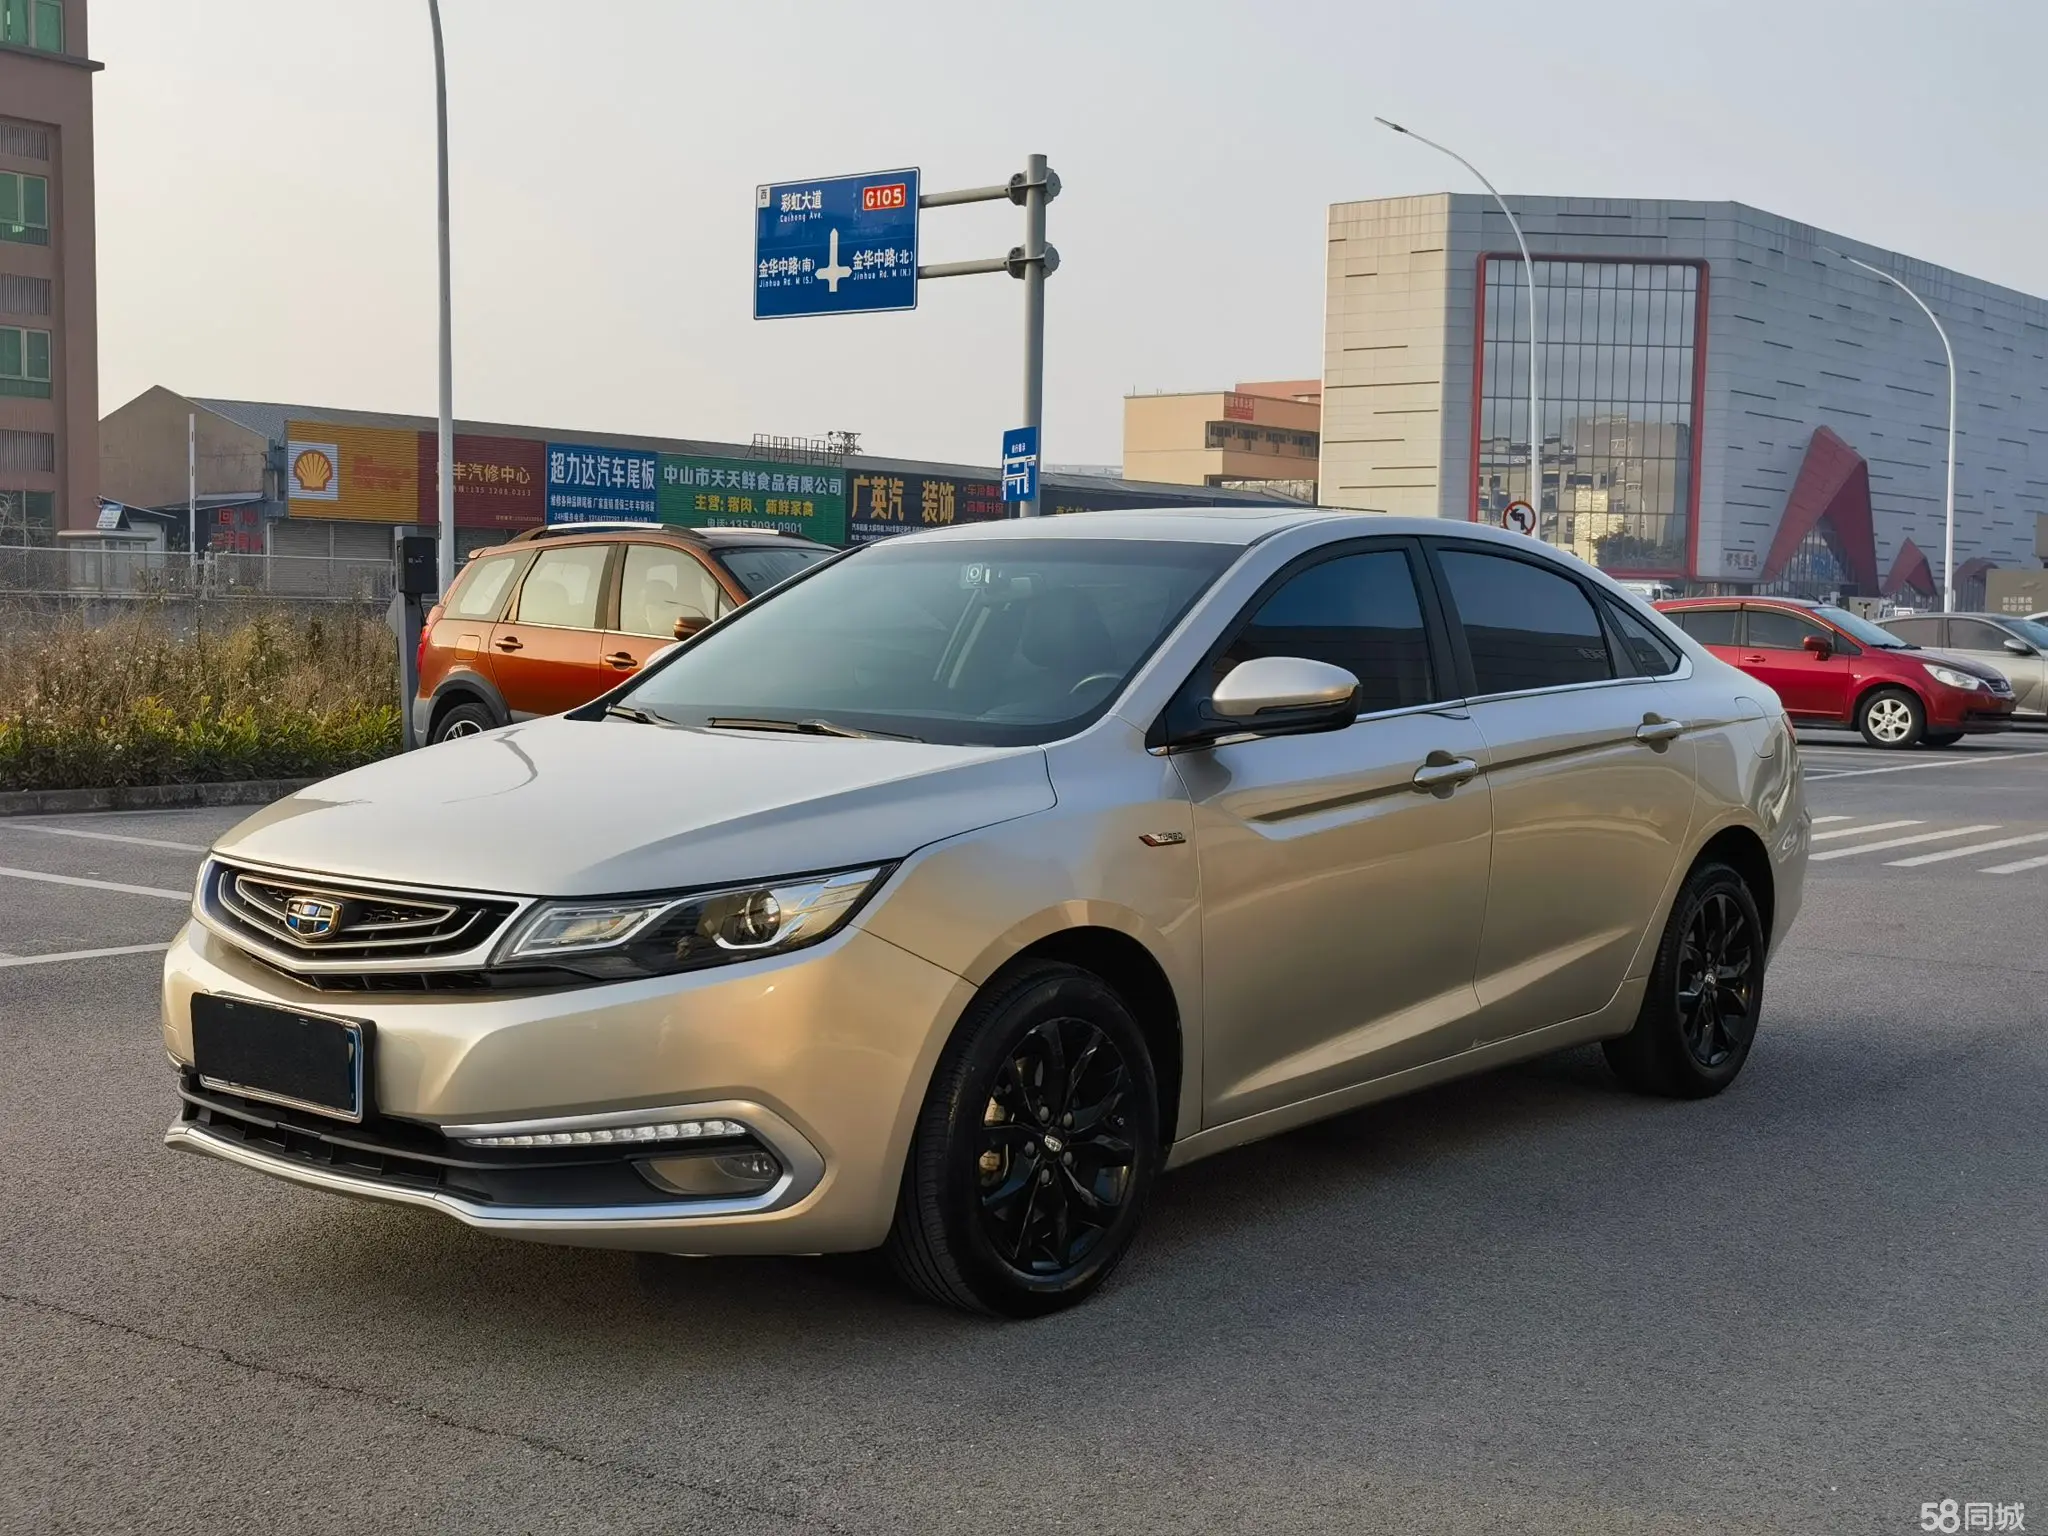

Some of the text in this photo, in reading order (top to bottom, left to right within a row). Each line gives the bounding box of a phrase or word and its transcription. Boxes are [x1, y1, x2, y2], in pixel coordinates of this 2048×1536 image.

[780, 190, 822, 213] 彩虹大道
[865, 188, 902, 207] G105
[779, 211, 823, 223] Caihong Ave.
[758, 256, 815, 278] 金华中路(南)
[852, 247, 914, 271] 金华中路(北)
[759, 278, 781, 288] Jinhua
[853, 271, 876, 281] Jinhua
[879, 270, 889, 279] Rd.
[435, 461, 531, 485] 丰汽修中心
[550, 451, 656, 490] 超力达汽车尾板
[663, 464, 843, 496] 中山市天天鲜食品有限公司
[851, 474, 956, 524] 广英汽 装饰
